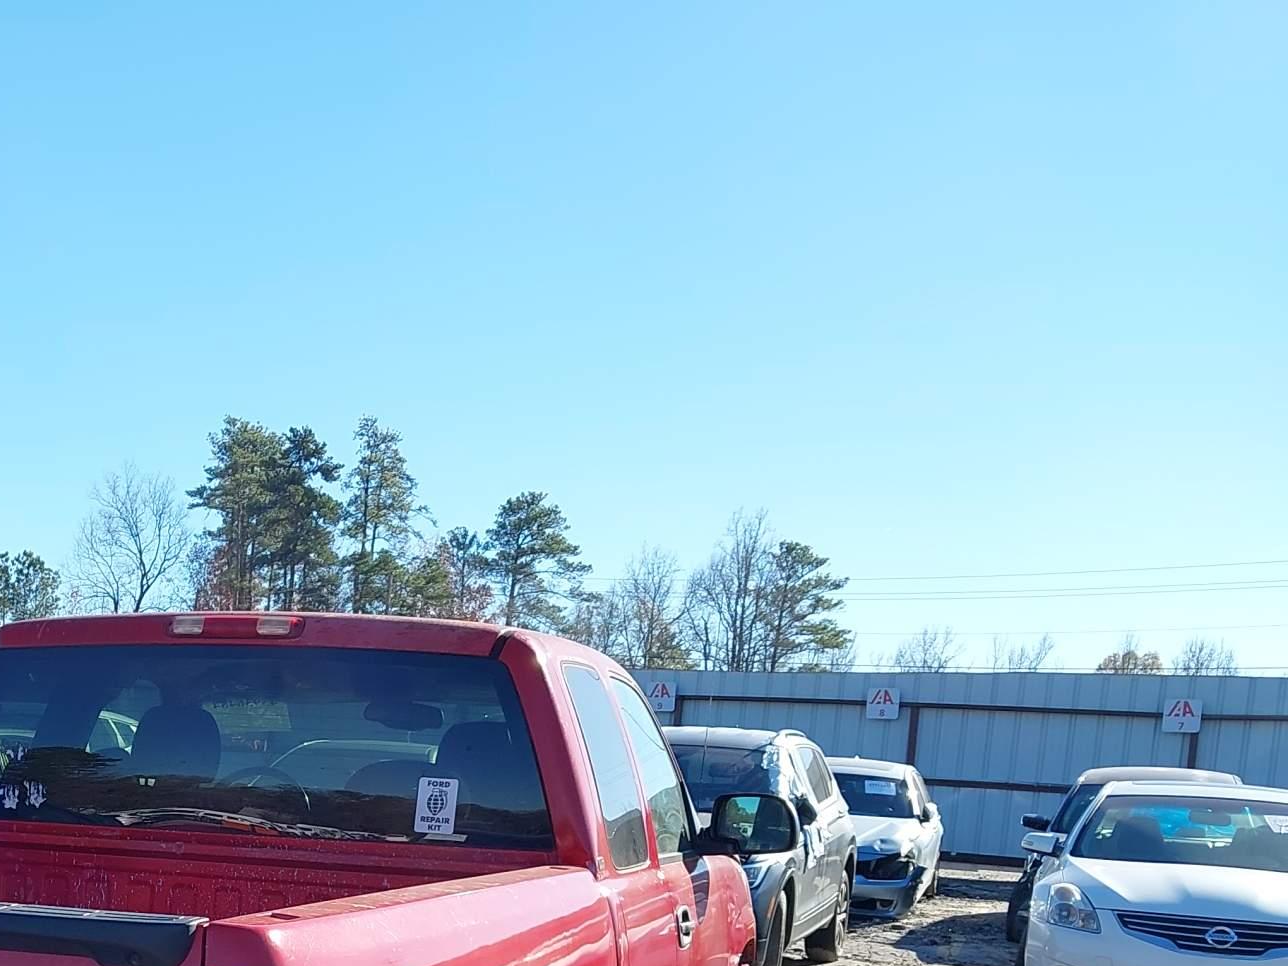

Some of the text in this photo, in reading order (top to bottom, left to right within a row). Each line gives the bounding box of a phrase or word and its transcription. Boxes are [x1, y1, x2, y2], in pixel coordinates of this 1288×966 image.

[656, 702, 663, 710] 9
[879, 708, 886, 717] 8
[1177, 721, 1185, 731] 7
[427, 780, 451, 788] FORD
[420, 815, 450, 825] REPAIR
